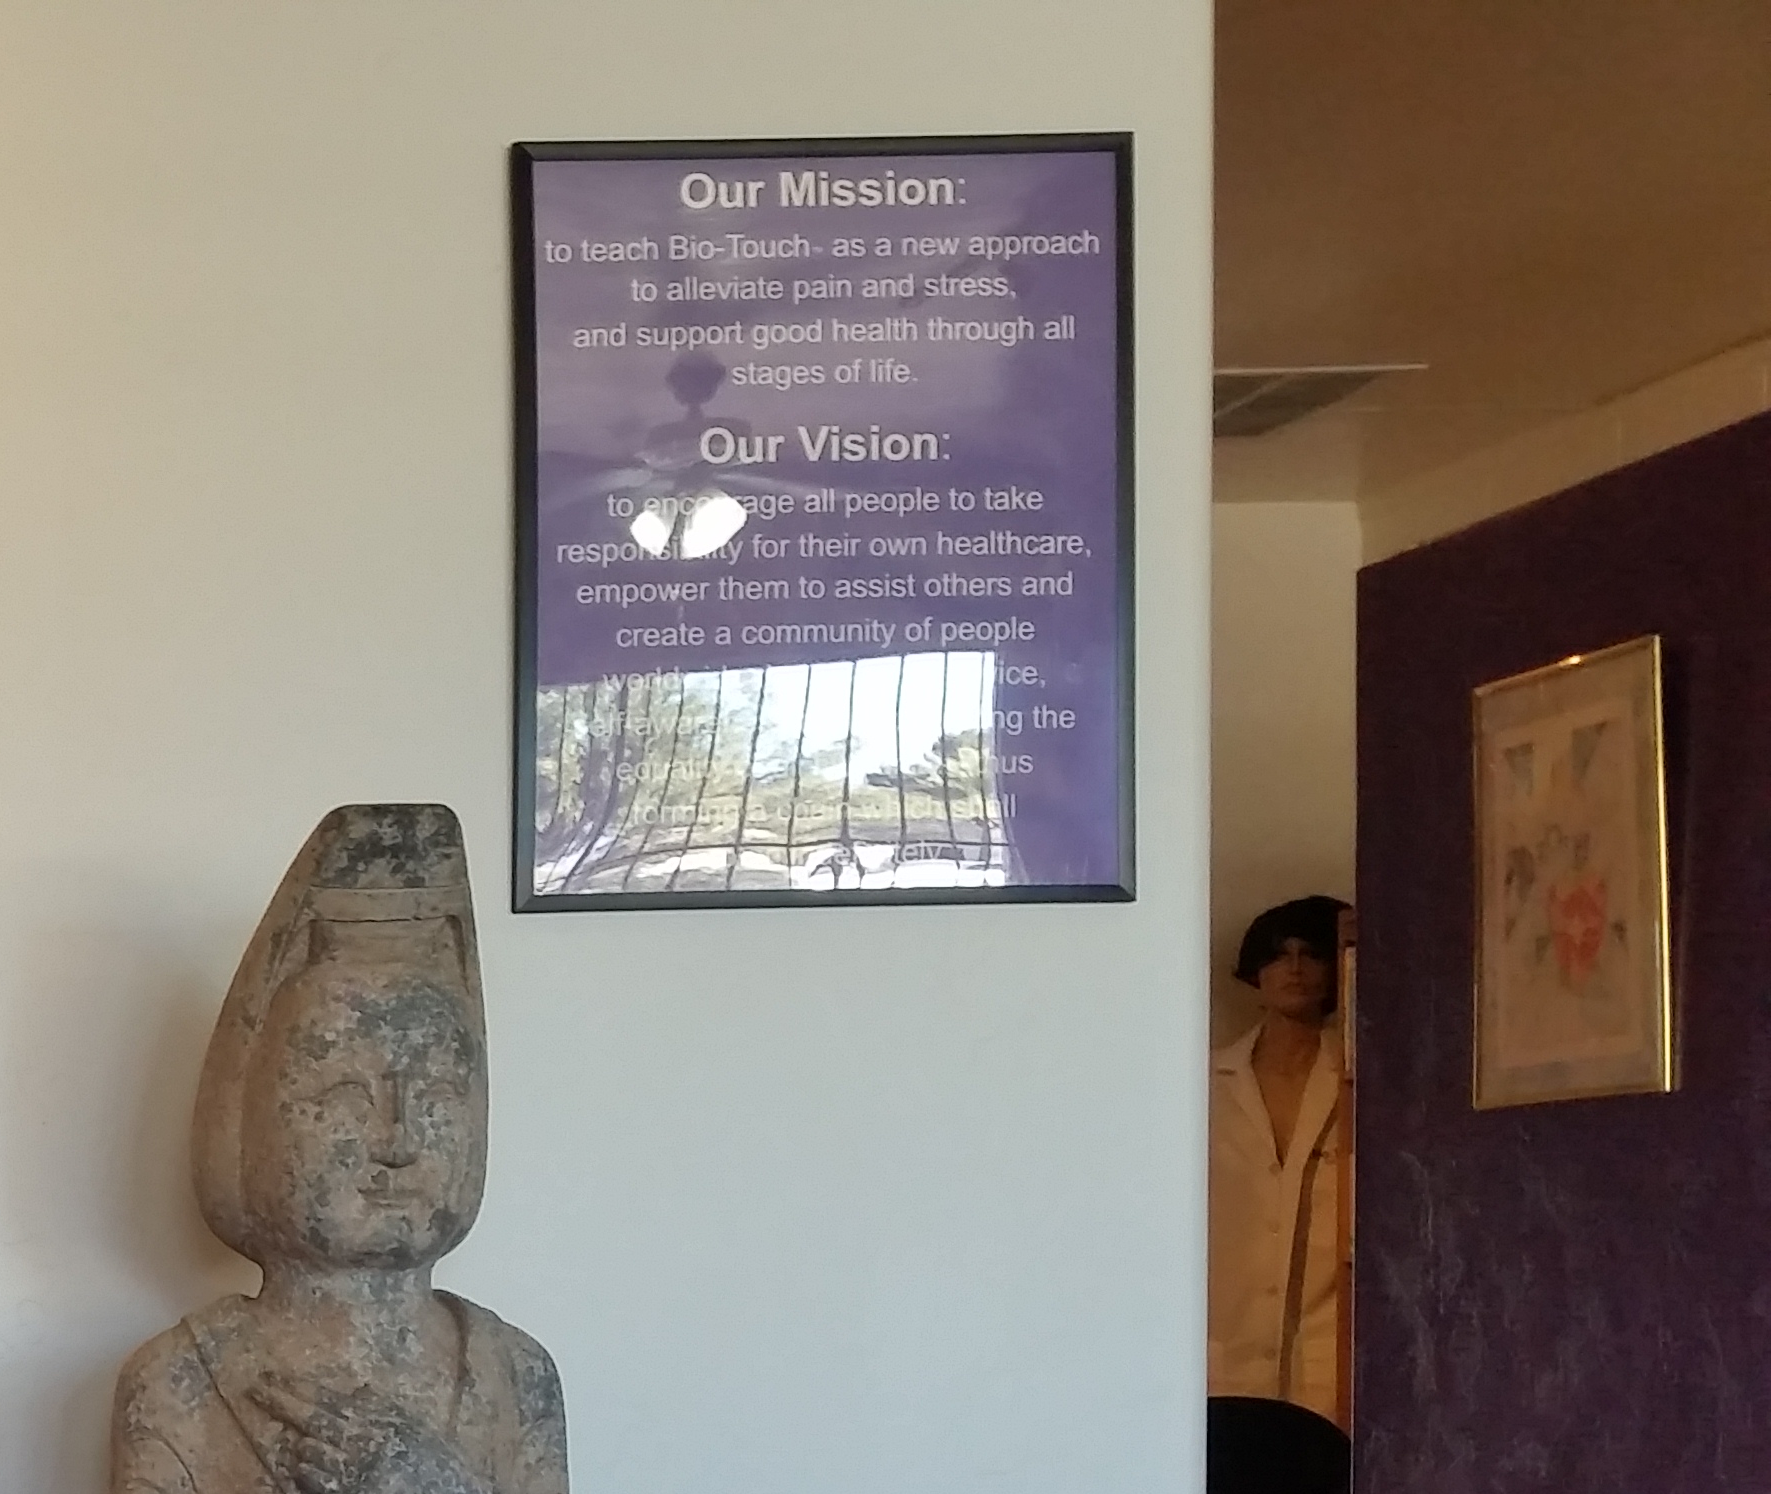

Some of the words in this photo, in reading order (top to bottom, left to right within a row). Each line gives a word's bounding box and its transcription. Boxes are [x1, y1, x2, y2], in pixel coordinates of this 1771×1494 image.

[680, 172, 766, 209] Our
[779, 169, 966, 207] Mission:
[544, 240, 573, 263] to
[580, 236, 659, 262] teach
[831, 238, 867, 258] as
[873, 237, 892, 257] a
[901, 237, 961, 257] new
[967, 229, 1100, 261] approach
[630, 278, 658, 302] to
[666, 275, 784, 302] alleviate
[792, 273, 853, 303] pain
[861, 272, 915, 298] and
[923, 273, 1017, 299] stress,
[572, 322, 626, 348] and
[635, 320, 745, 350] support
[750, 318, 823, 349] good
[831, 316, 918, 342] health
[926, 315, 1035, 346] through
[1042, 314, 1075, 340] all
[731, 361, 826, 391] stages
[833, 358, 863, 384] of
[869, 357, 918, 383] life.
[698, 427, 785, 465] Our
[797, 425, 950, 462] Vision:
[606, 493, 635, 517] to
[800, 487, 836, 513] all
[843, 486, 941, 518] people
[948, 487, 976, 512] to
[983, 485, 1044, 511] take
[751, 533, 791, 559] for
[798, 532, 862, 558] their
[868, 537, 927, 557] own
[937, 530, 1091, 558] healthcare,
[576, 582, 711, 606] empower
[718, 575, 789, 601] them
[798, 576, 826, 599] to
[833, 573, 917, 599] assist
[923, 572, 1013, 597] others
[1020, 570, 1073, 597] and
[615, 622, 706, 648] create
[714, 626, 732, 646] a
[740, 617, 897, 646] community
[904, 616, 934, 643] of
[940, 615, 1036, 645] people
